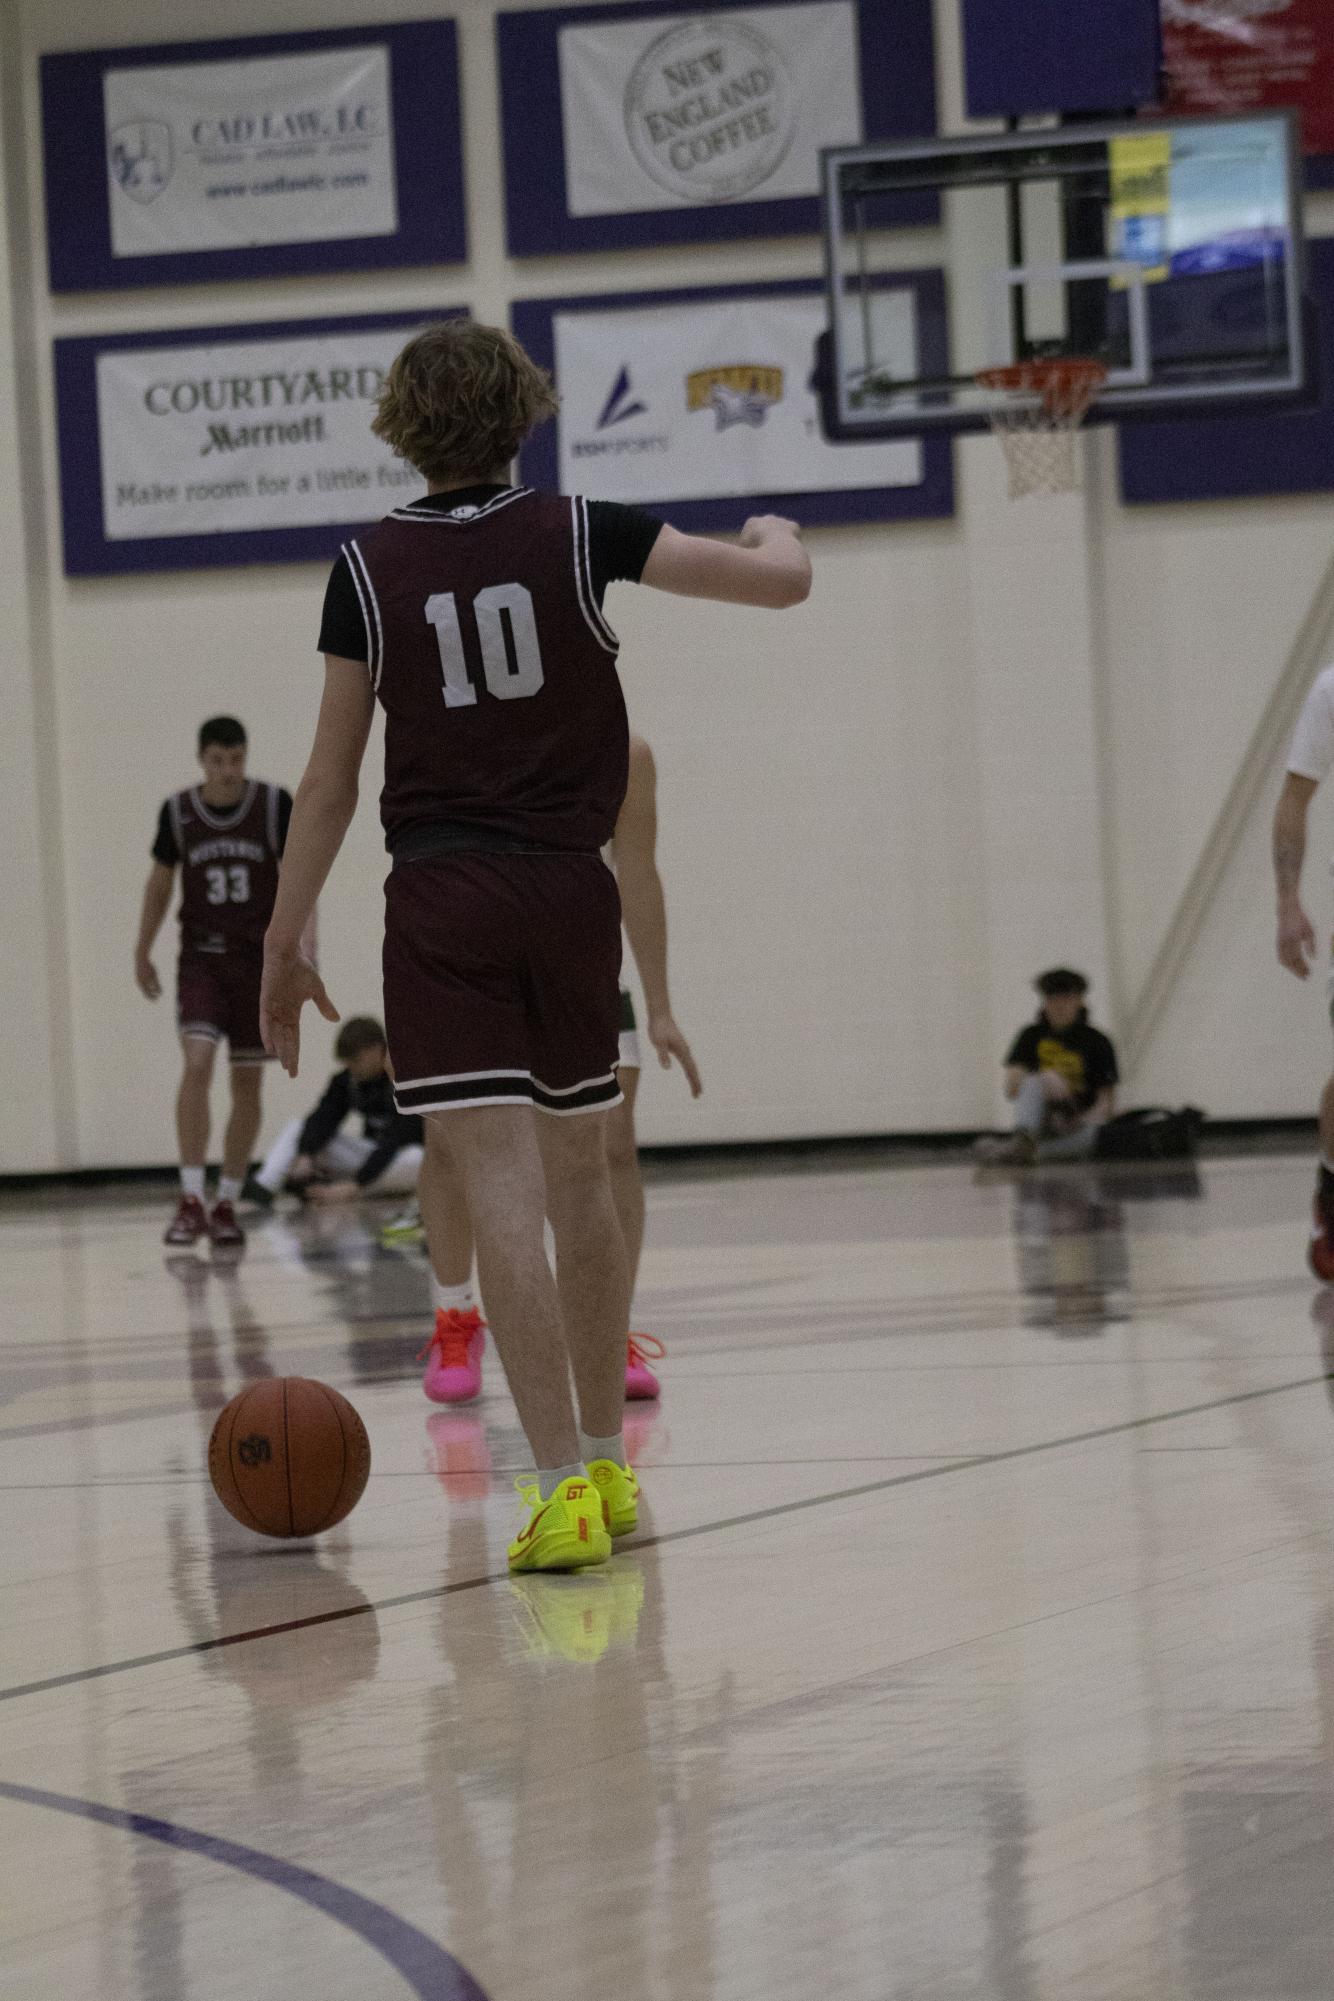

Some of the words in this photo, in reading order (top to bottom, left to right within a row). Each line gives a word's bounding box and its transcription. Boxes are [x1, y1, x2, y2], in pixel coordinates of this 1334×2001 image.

[662, 49, 724, 97] NEW
[643, 69, 772, 144] ENGLAND
[192, 118, 255, 144] CAD
[669, 106, 777, 172] COFFEE
[144, 367, 385, 415] COURTYARD
[200, 415, 324, 456] Marriott
[117, 485, 177, 506] Make
[184, 480, 247, 501] room
[257, 474, 291, 496] for
[298, 476, 310, 493] a
[317, 465, 370, 490] little
[424, 582, 545, 708] 10
[206, 867, 251, 905] 33
[566, 1484, 588, 1501] GT
